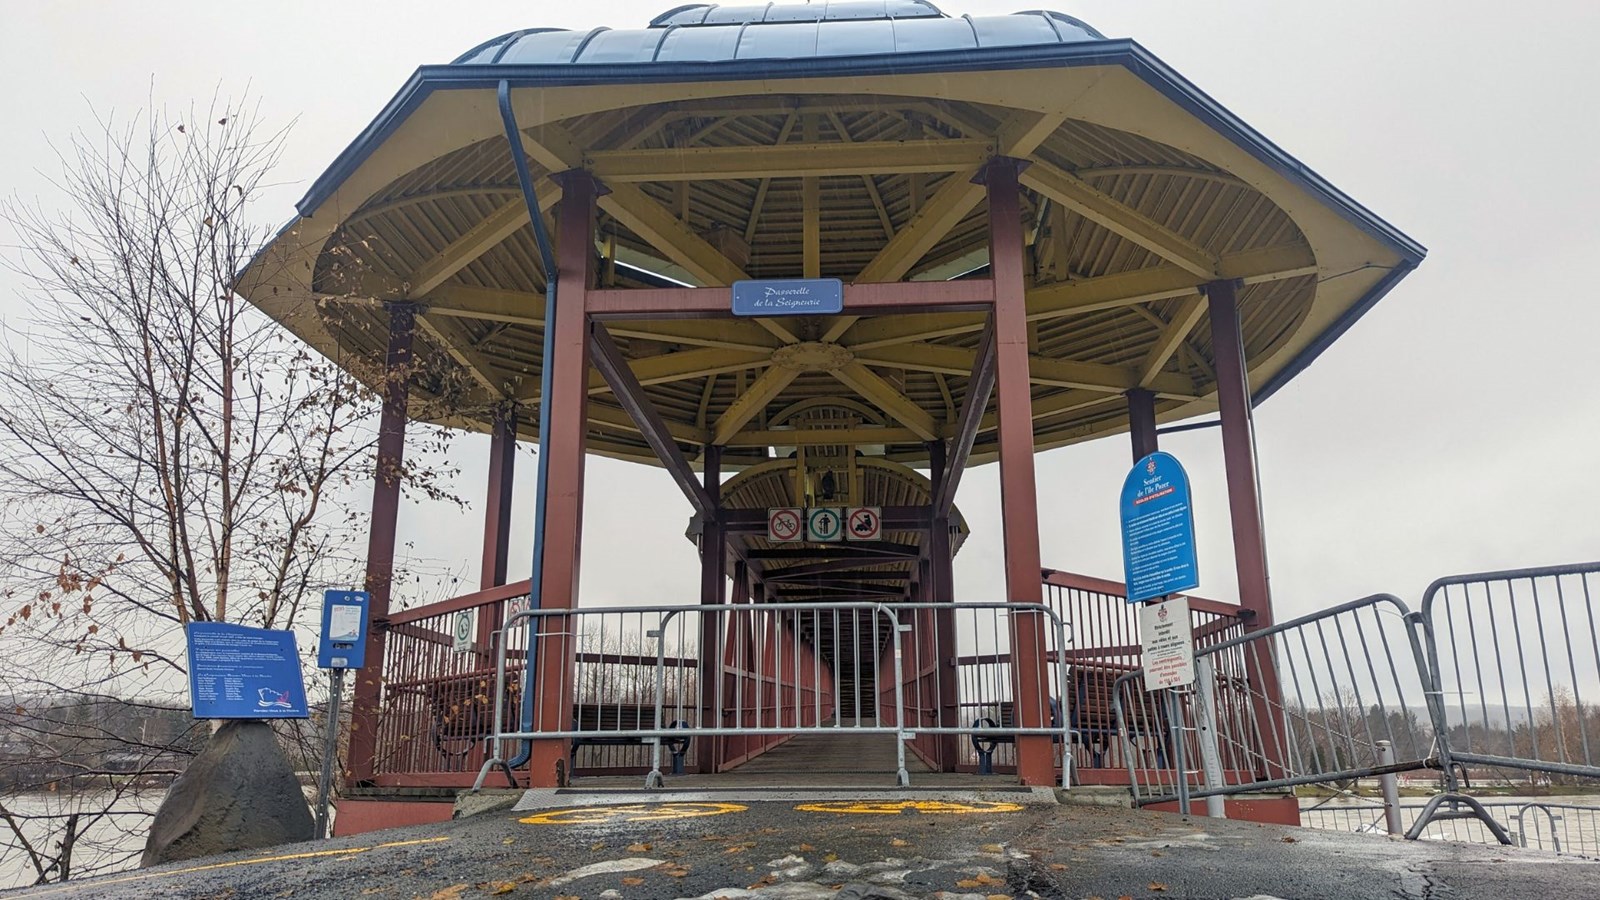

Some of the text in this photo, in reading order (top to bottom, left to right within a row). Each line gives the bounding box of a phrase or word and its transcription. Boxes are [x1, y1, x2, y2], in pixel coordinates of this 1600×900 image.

[764, 287, 810, 297] Passerelle
[764, 298, 773, 307] la
[775, 297, 821, 308] Seigneurie
